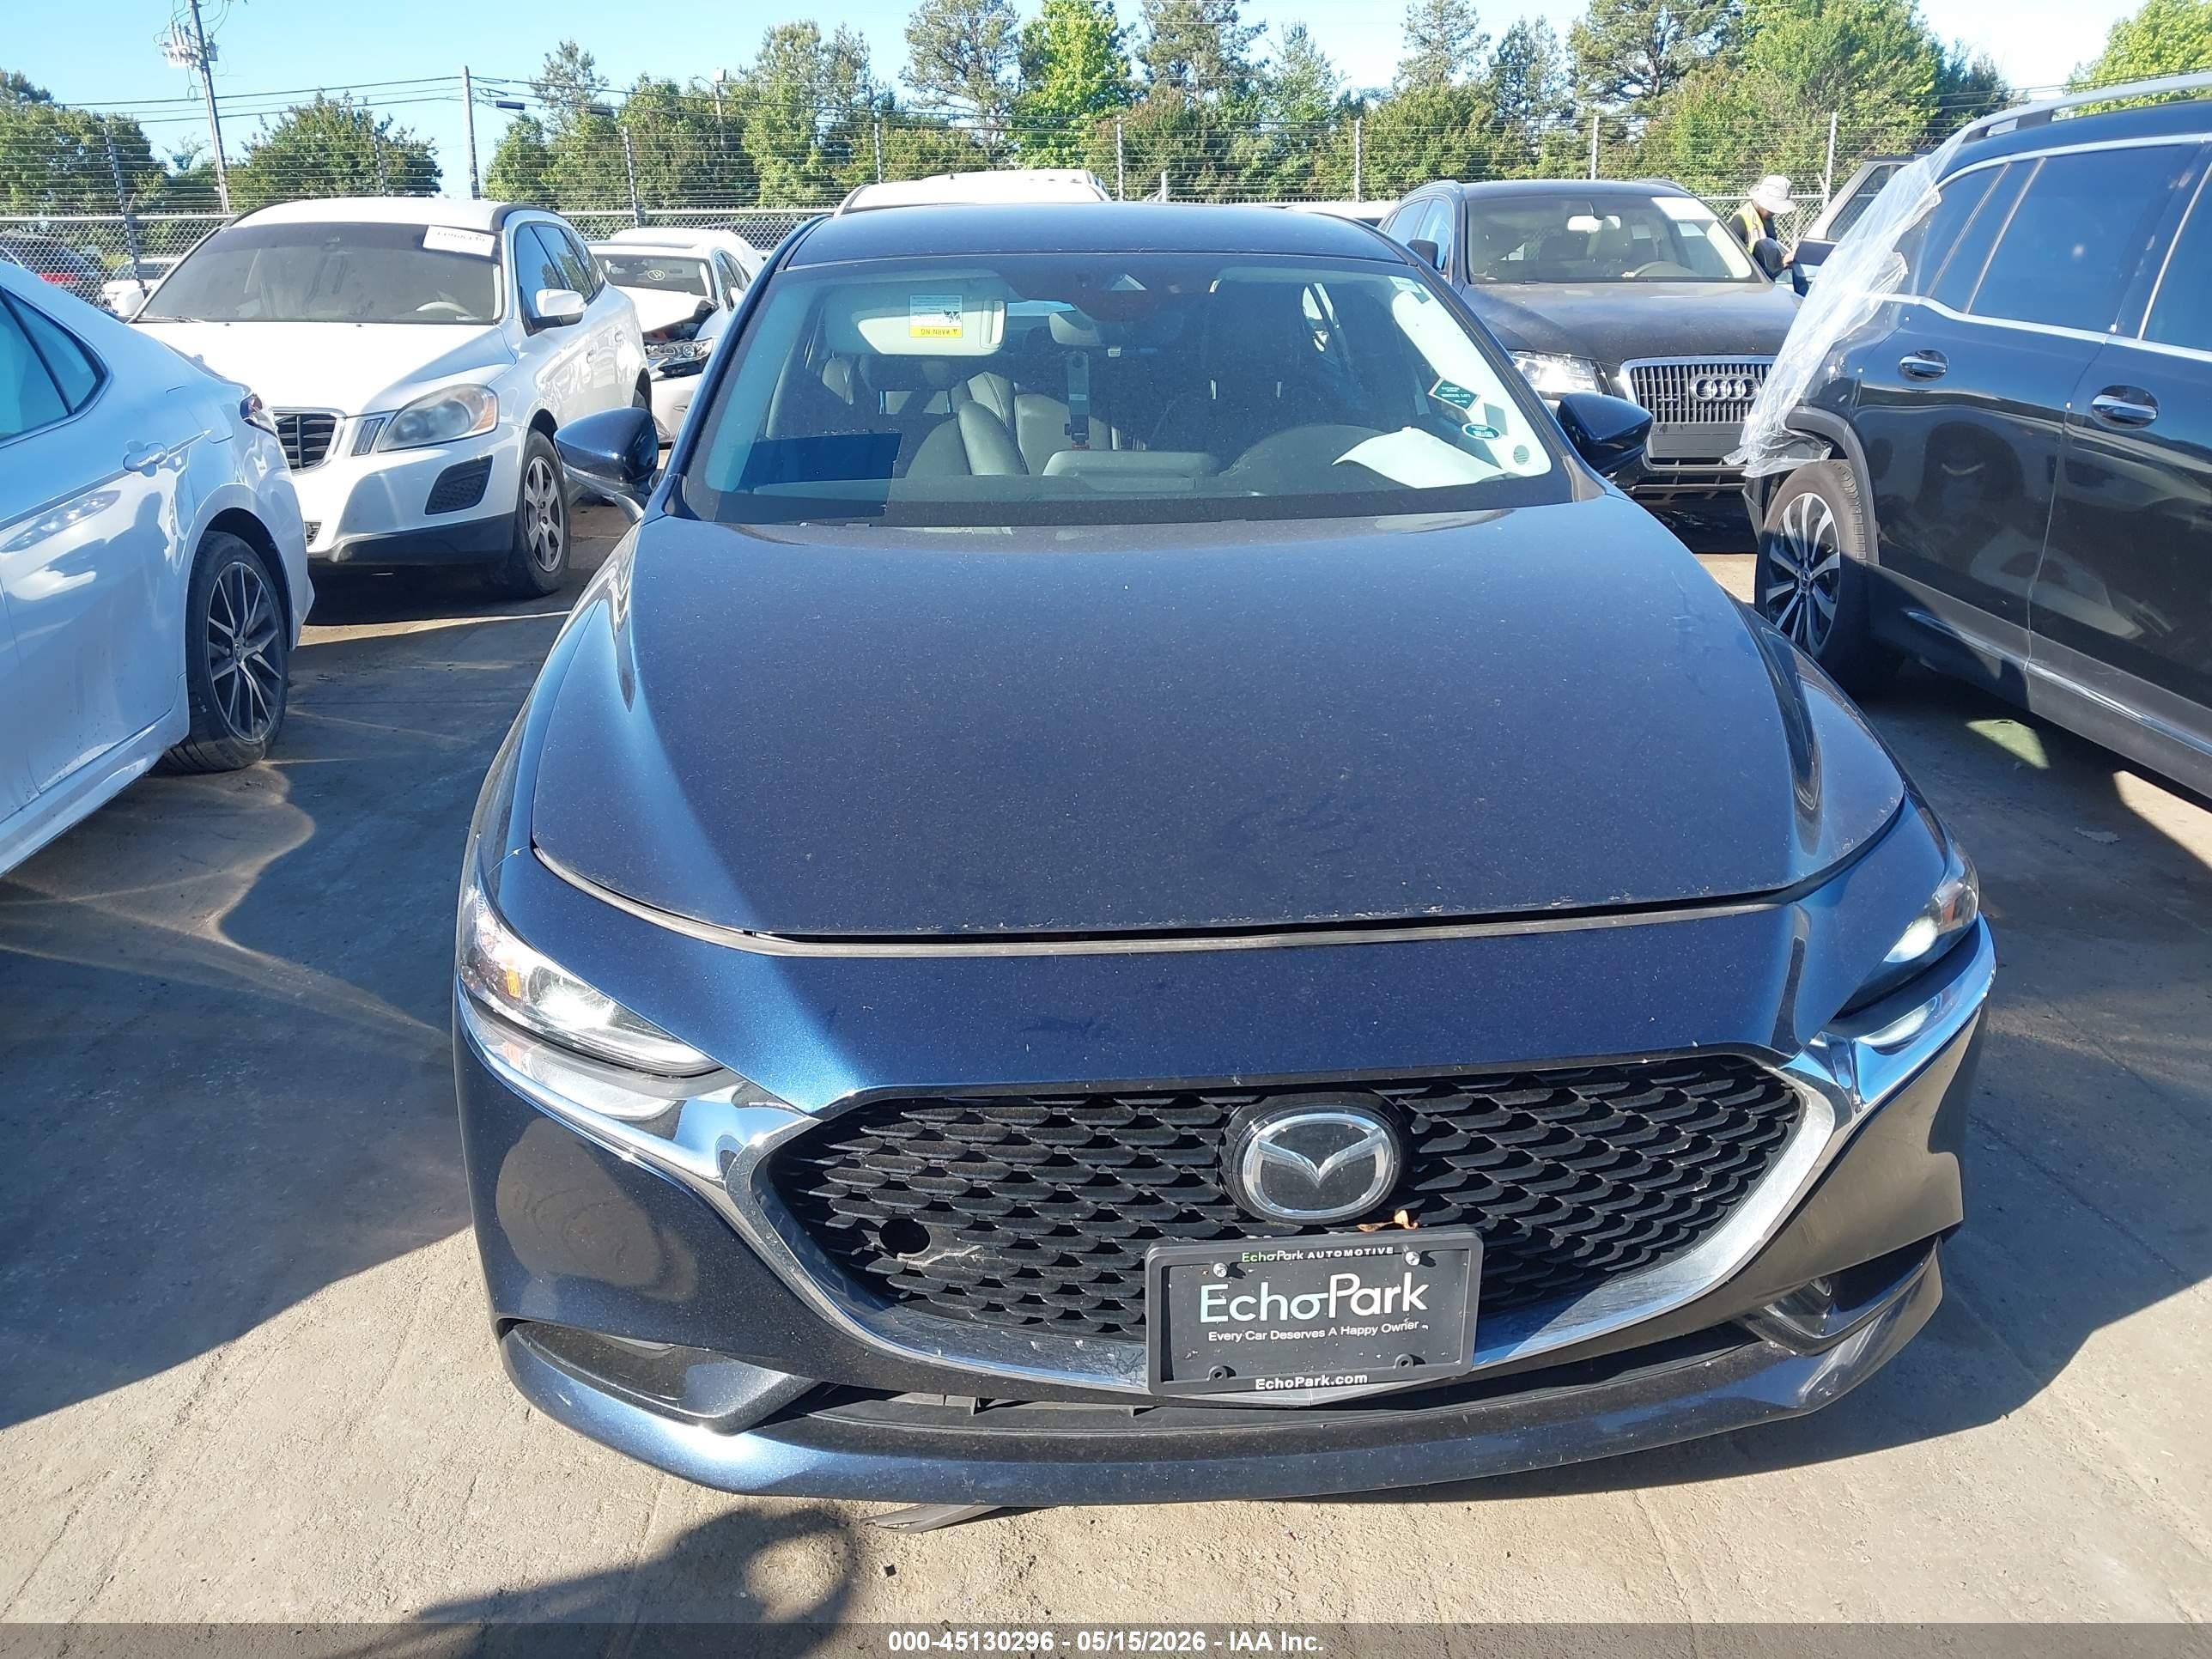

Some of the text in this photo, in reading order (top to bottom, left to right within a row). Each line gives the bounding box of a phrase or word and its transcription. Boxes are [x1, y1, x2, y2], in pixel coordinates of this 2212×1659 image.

[1242, 1246, 1395, 1263] EchoPark AUTOMOTIVE
[1200, 1272, 1430, 1323] EchoPark
[1208, 1321, 1419, 1343] Every Car Deserves A Happy Owner
[1255, 1372, 1368, 1391] EchoPark.com
